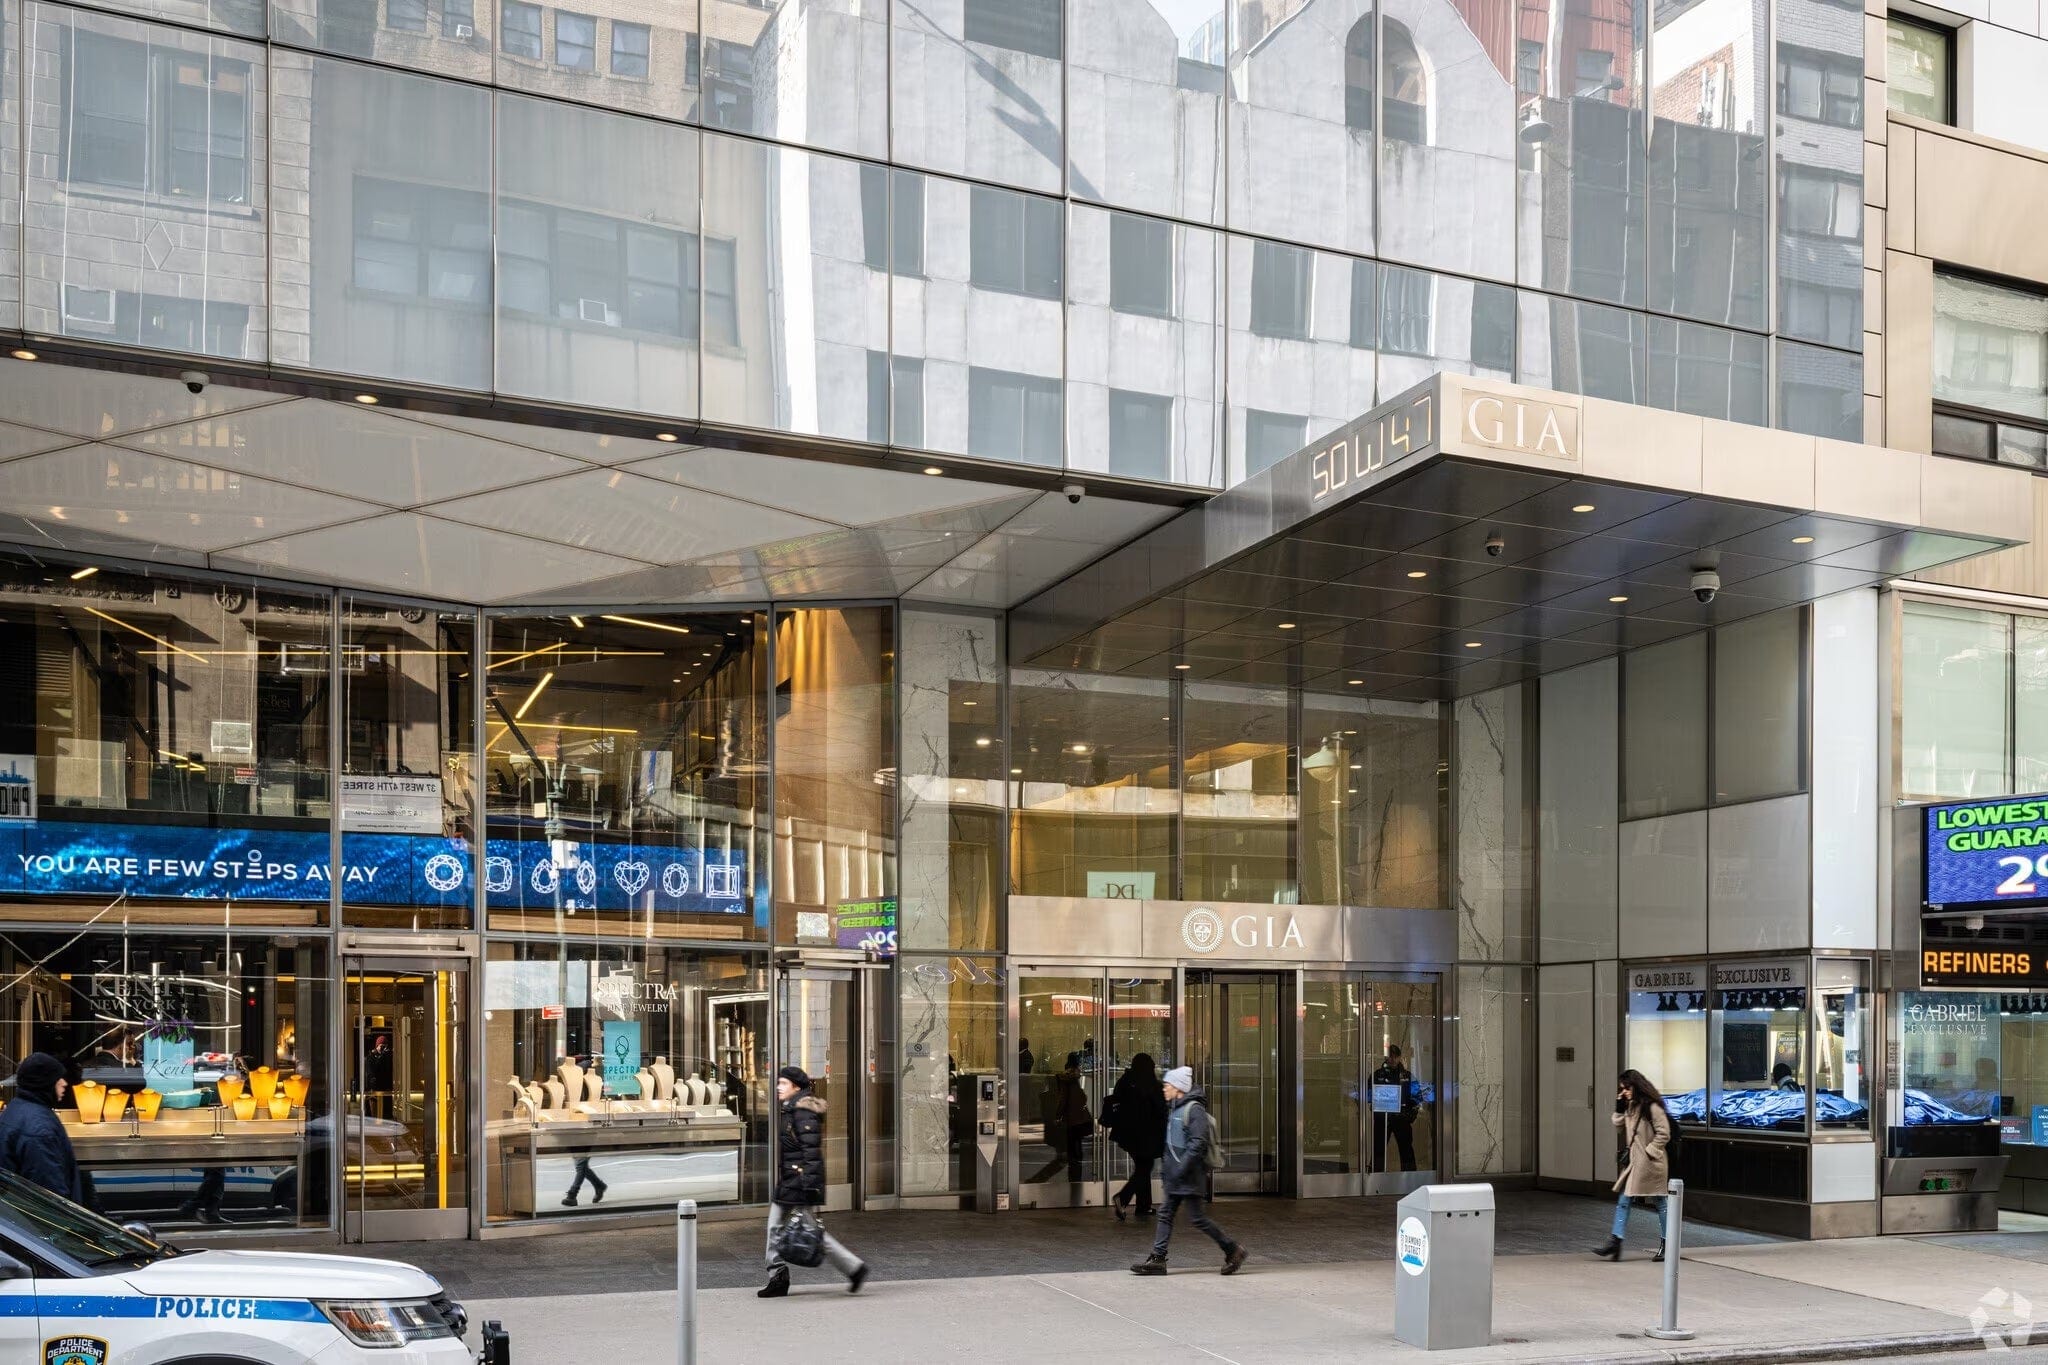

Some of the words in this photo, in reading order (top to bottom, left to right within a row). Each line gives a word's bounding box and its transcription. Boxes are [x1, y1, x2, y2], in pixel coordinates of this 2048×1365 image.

[1468, 396, 1567, 455] GIA
[18, 854, 74, 873] YOU
[84, 857, 138, 876] ARE
[148, 858, 206, 878] FEW
[306, 864, 379, 883] AWAY
[1231, 914, 1306, 948] GIA
[1924, 951, 2031, 974] REFINERS
[1634, 971, 1695, 988] GABRIEL
[1715, 967, 1791, 985] EXCLUSIVE
[597, 982, 679, 1000] SPECTRA
[90, 1000, 125, 1011] NEW
[133, 1000, 176, 1011] YORK
[630, 1003, 669, 1013] JEWELRY
[1911, 1004, 1987, 1022] GABRIEL
[1911, 1024, 1987, 1035] EXCLUSIVE
[145, 1057, 192, 1080] Kent
[158, 1297, 253, 1319] POLICE
[47, 1345, 104, 1359] DEPARTMENT
[60, 1338, 94, 1347] POLICE
